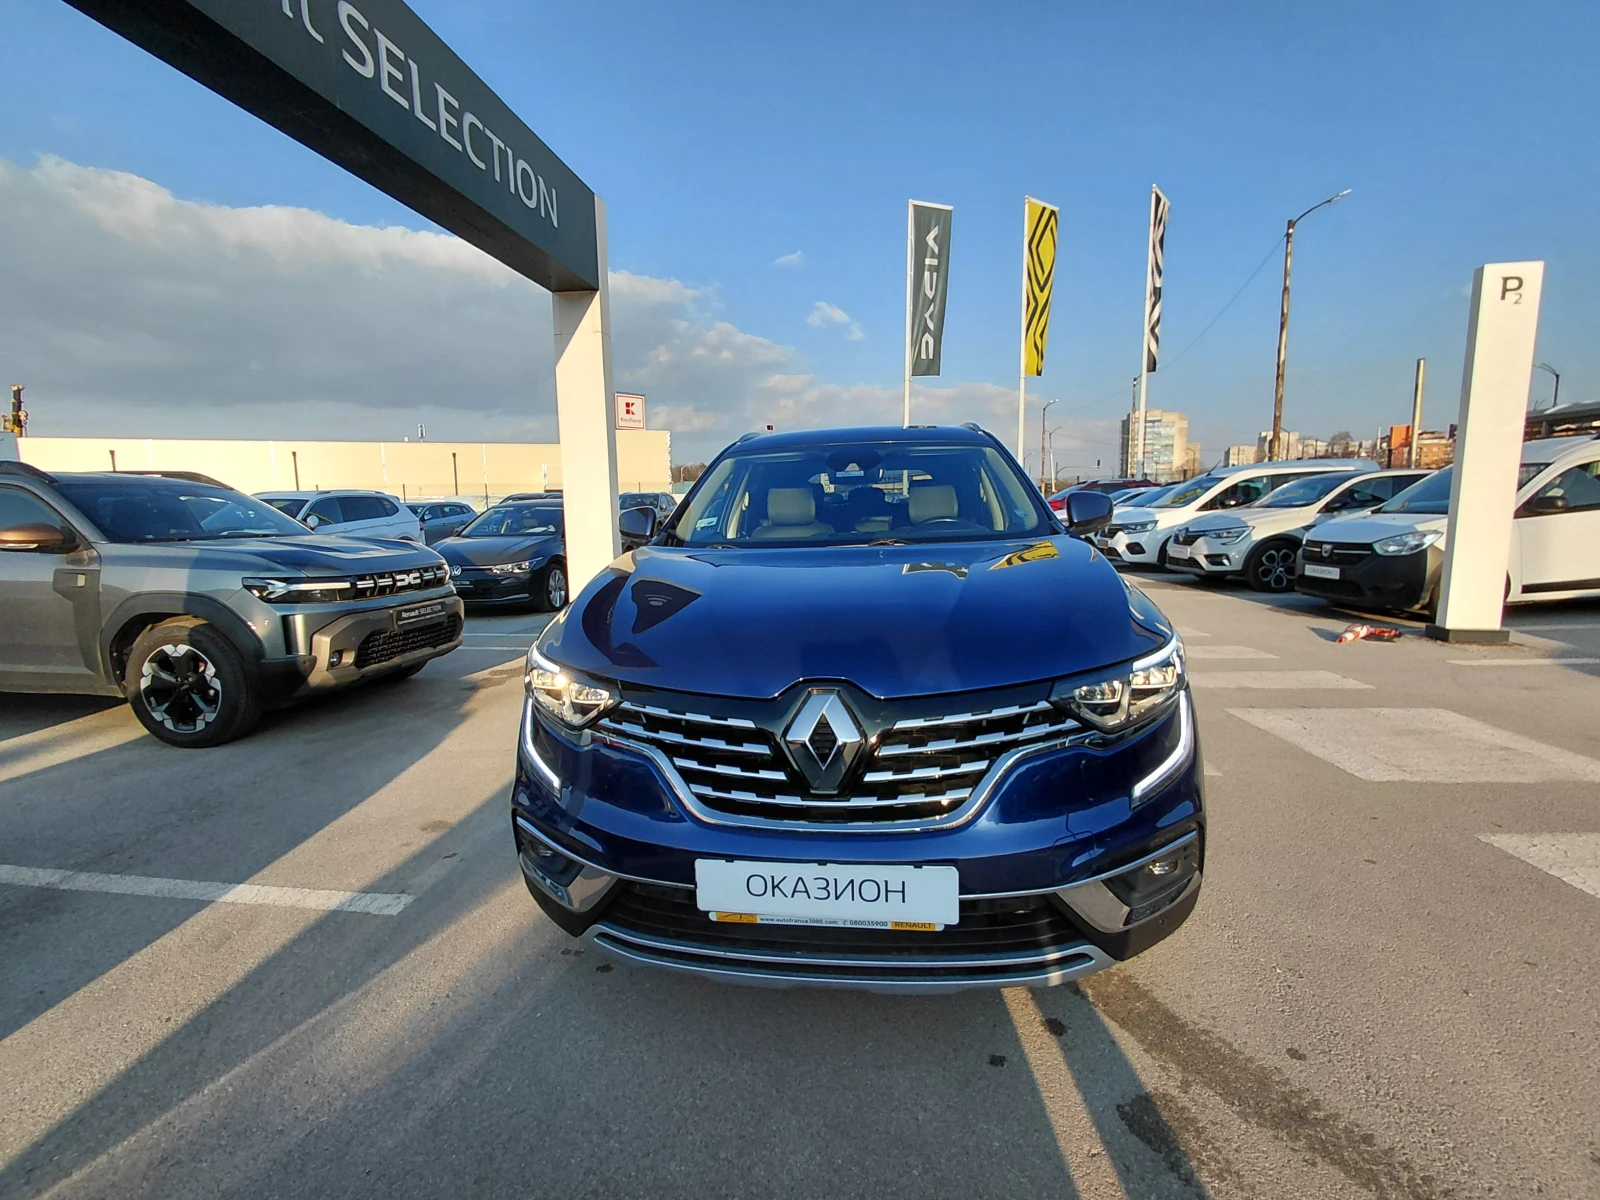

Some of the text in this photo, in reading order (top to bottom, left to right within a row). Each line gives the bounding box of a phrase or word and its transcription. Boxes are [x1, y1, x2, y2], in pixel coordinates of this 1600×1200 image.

[337, 0, 559, 229] SELECTION
[401, 609, 419, 618] Renault
[419, 604, 442, 614] SELECTION
[746, 873, 906, 903] ОКАЗИОН
[894, 921, 932, 929] RENAULT
